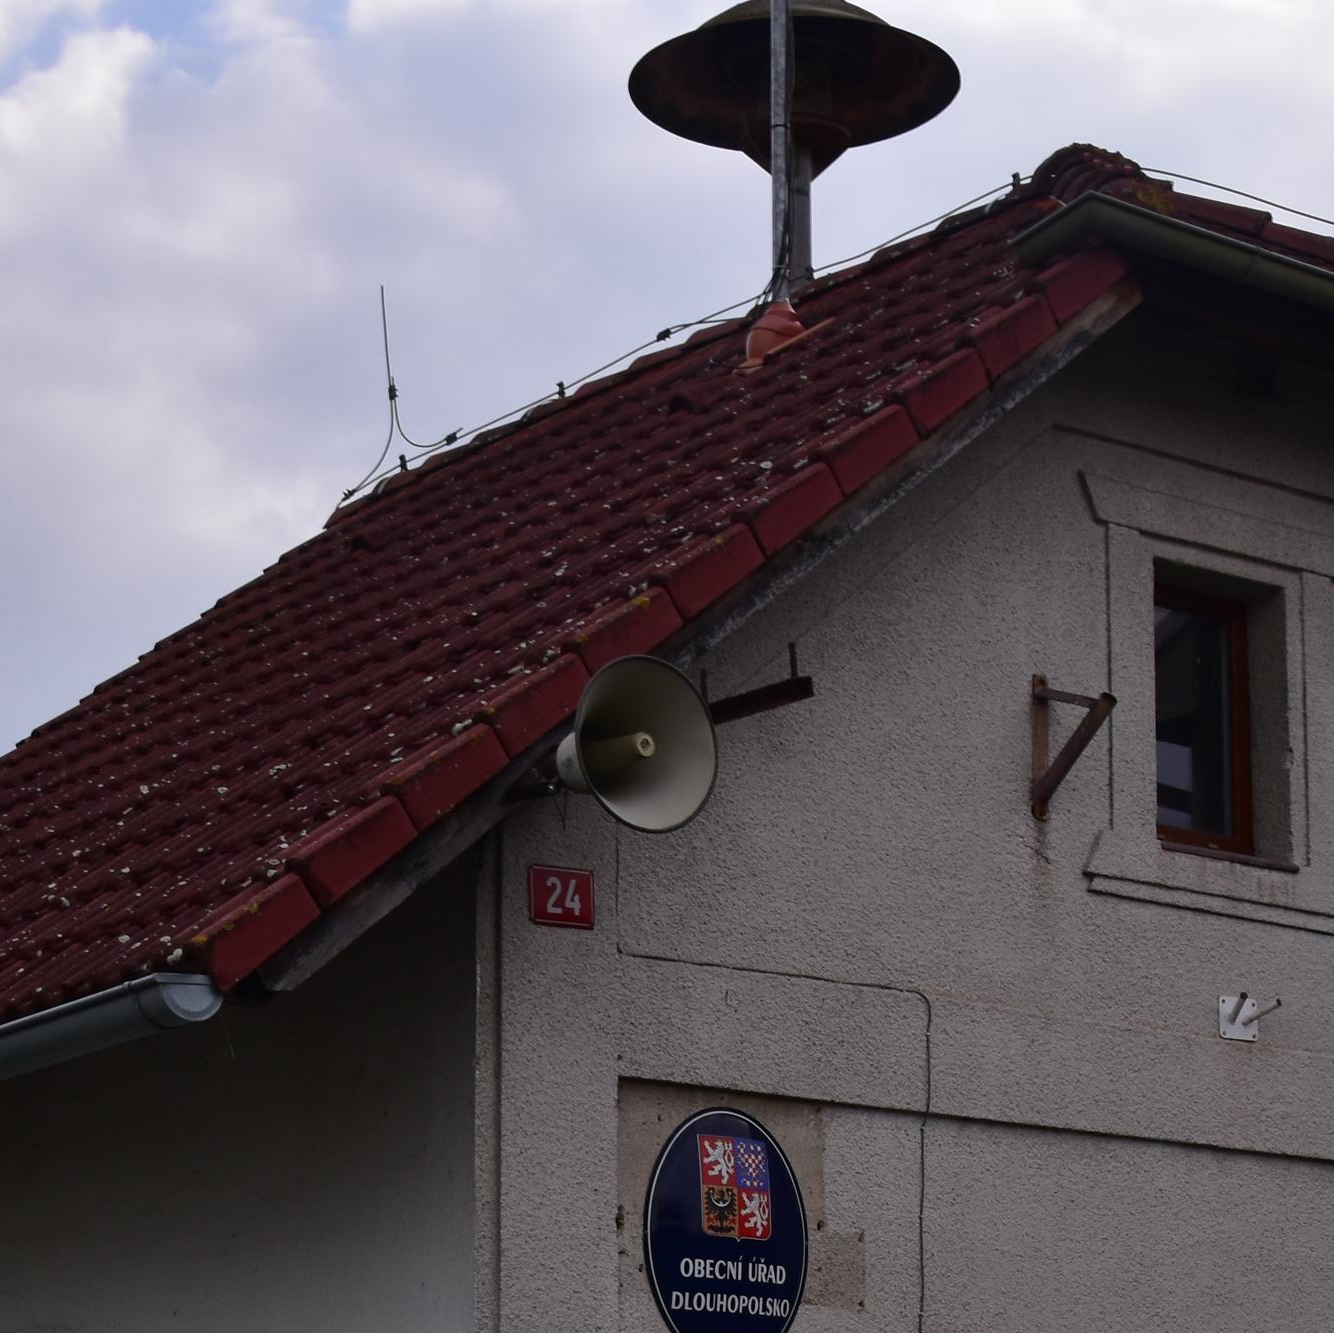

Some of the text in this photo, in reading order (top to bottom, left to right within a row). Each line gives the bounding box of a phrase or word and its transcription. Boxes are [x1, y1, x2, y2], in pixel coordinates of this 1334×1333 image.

[546, 876, 581, 917] 24
[680, 1254, 786, 1285] OBECNÍ ÚŘAD
[671, 1291, 790, 1318] DLOUHOPOLSKO
